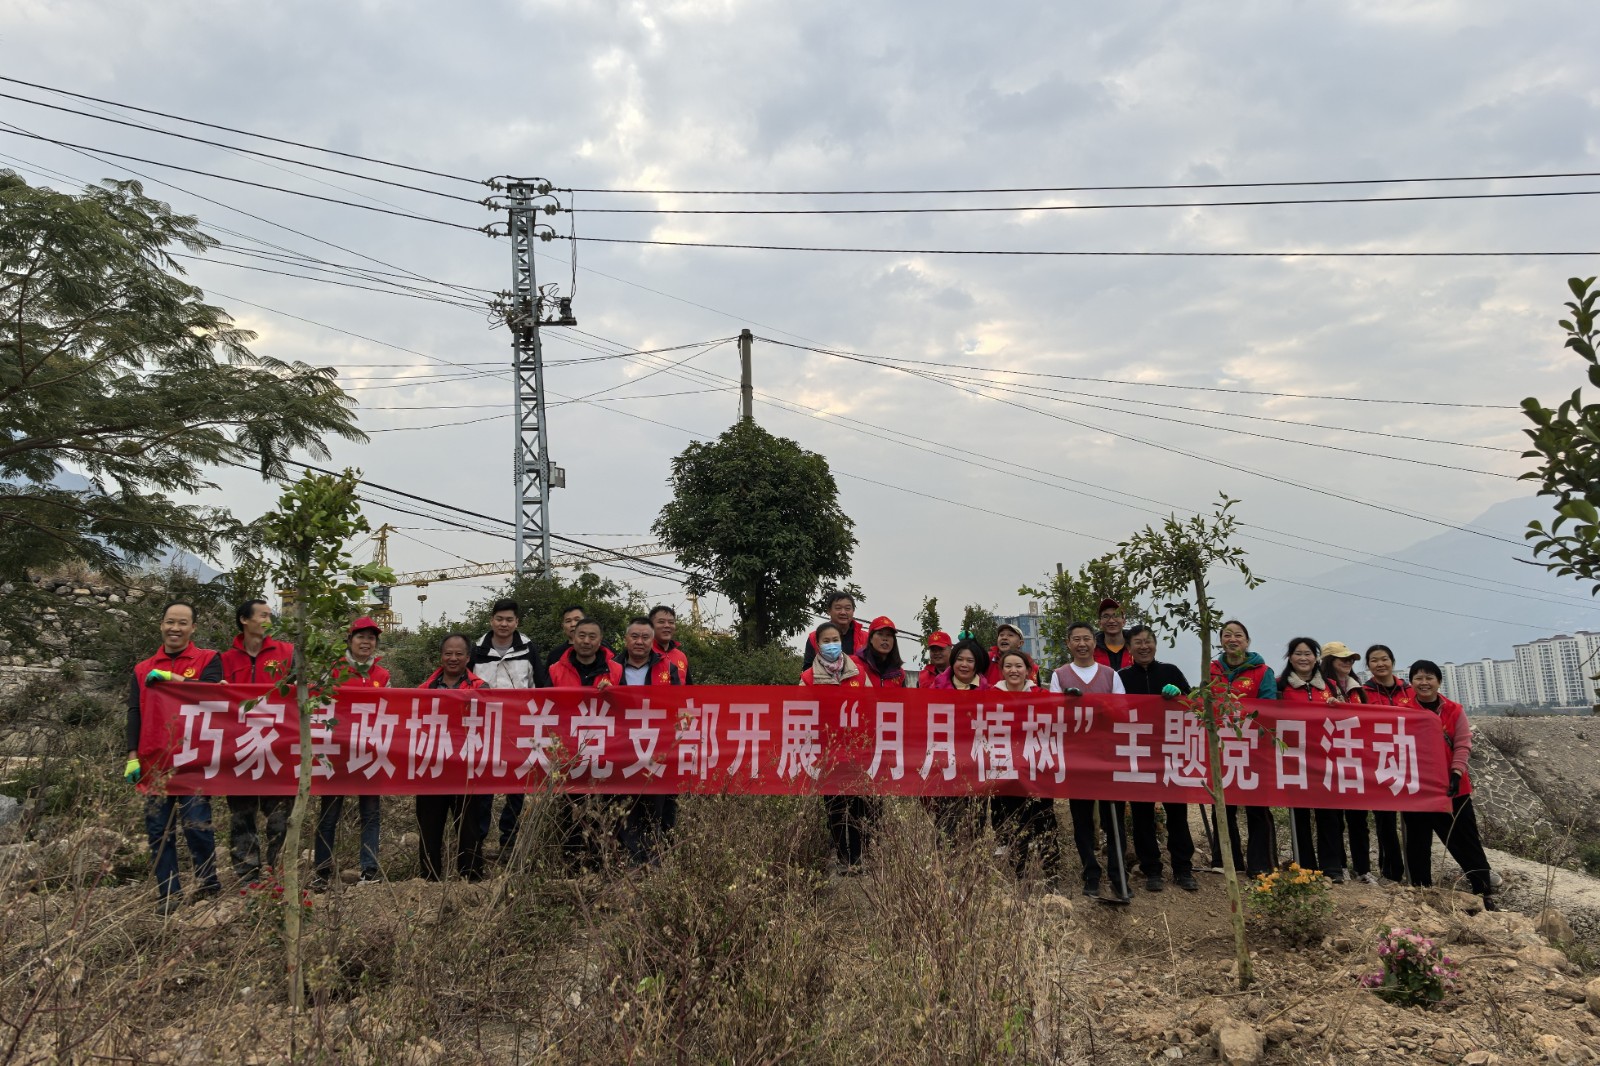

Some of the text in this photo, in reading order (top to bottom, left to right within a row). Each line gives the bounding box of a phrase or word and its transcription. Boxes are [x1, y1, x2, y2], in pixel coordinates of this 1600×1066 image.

[173, 698, 1420, 797] 巧家县政协机关党支部开展“月月植树”主题党日活动
